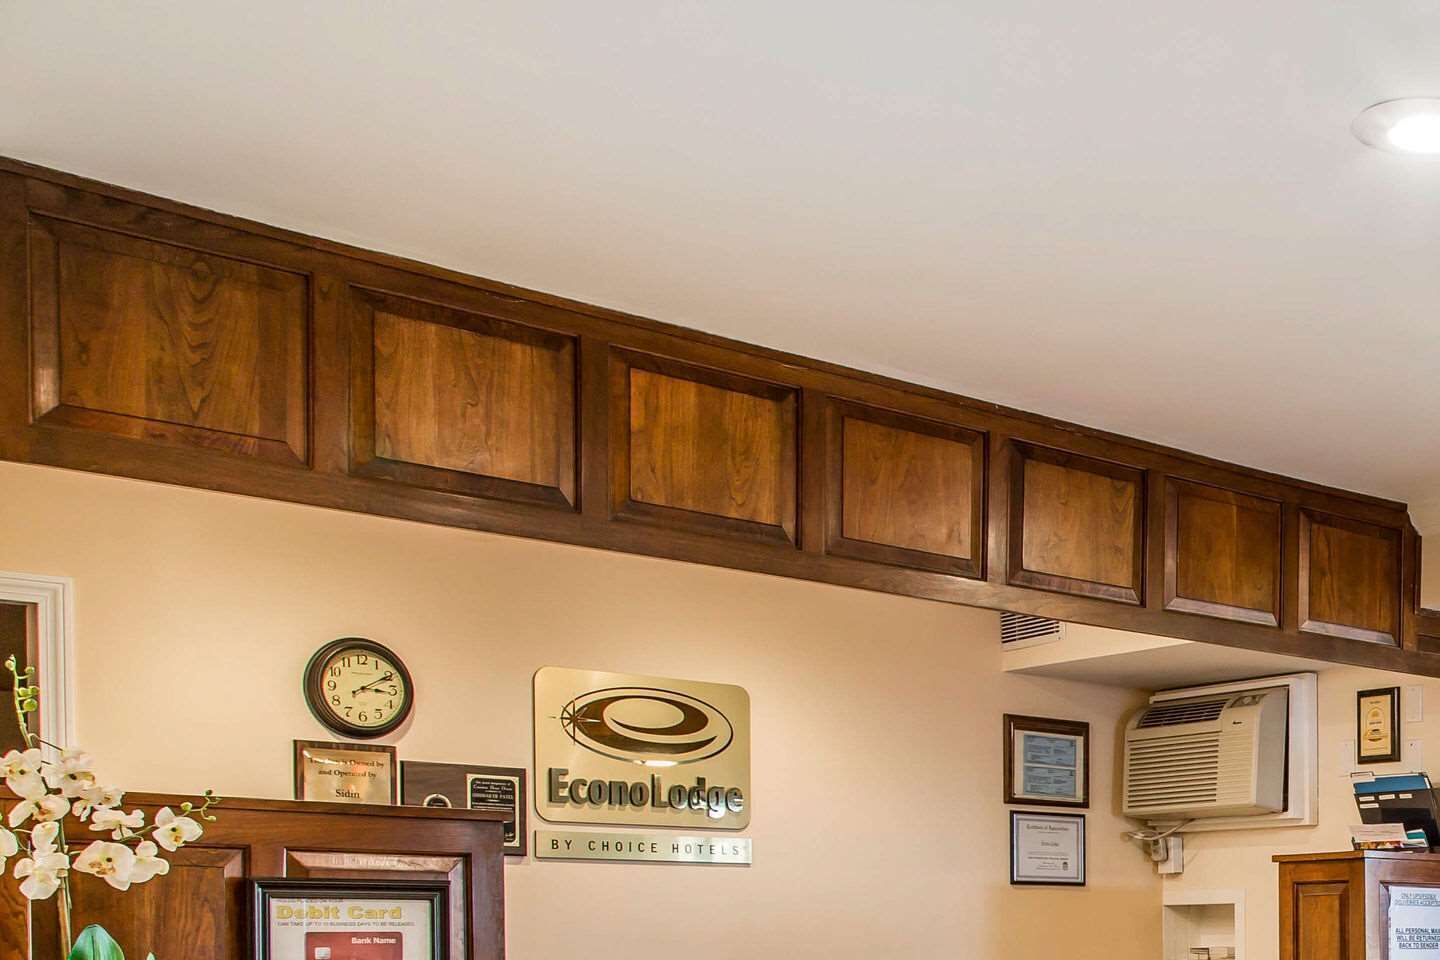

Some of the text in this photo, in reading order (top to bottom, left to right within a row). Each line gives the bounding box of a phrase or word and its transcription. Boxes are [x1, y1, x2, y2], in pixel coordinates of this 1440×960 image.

[342, 656, 351, 668] 11
[356, 654, 368, 665] 12
[375, 660, 378, 670] 1
[330, 666, 341, 677] 10
[384, 670, 393, 682] 2
[327, 680, 337, 691] 9
[388, 685, 398, 696] 3
[331, 695, 341, 706] 8
[385, 699, 393, 709] 4
[344, 706, 353, 717] 7
[358, 711, 368, 722] 6
[374, 708, 383, 719] 5
[368, 770, 377, 778] by
[548, 767, 744, 819] EconoLodge
[551, 839, 740, 856] BY CHOICE HOTELS
[275, 905, 403, 919] Debit Card
